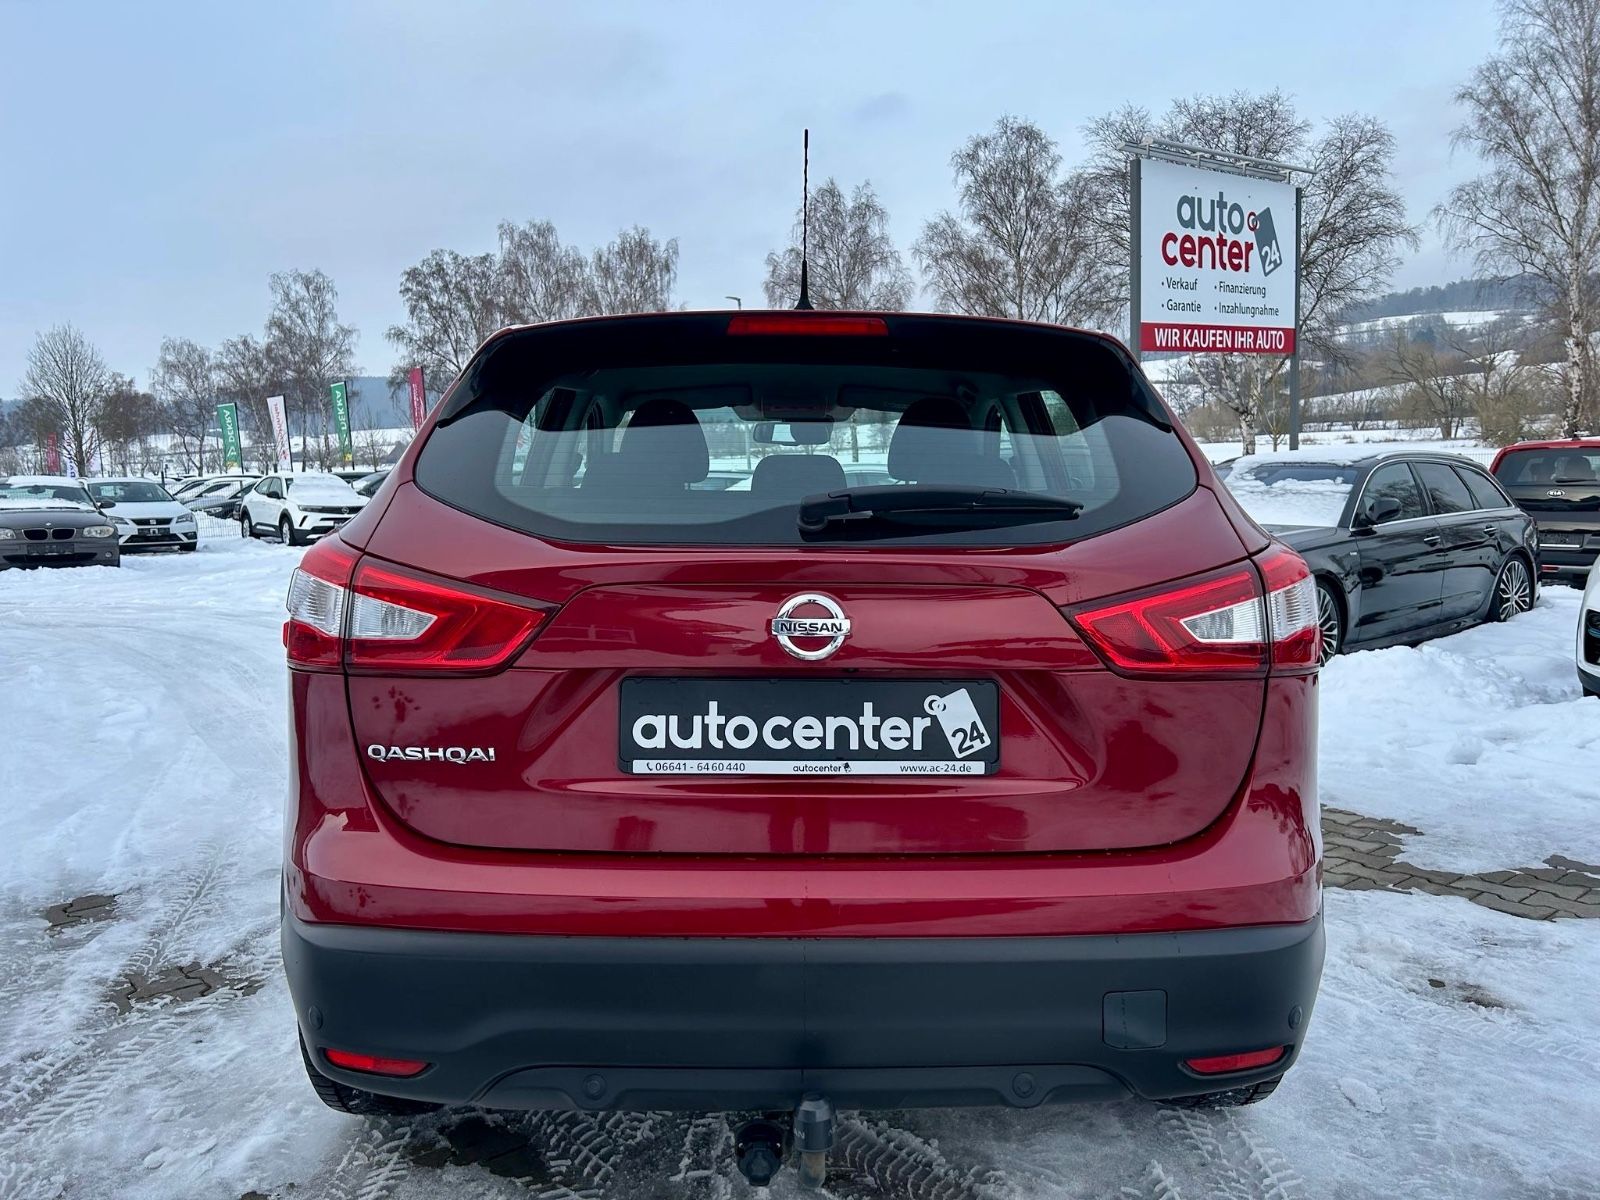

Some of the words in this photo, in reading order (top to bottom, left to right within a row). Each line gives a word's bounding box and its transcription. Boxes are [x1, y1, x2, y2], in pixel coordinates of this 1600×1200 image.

[1177, 192, 1244, 235] auto
[1161, 232, 1254, 272] center
[1261, 240, 1280, 273] 24
[1166, 277, 1198, 291] Verkauf
[1219, 281, 1266, 298] Finanzierung
[1166, 299, 1201, 313] Garantie
[1219, 302, 1280, 318] Inzahlungnahme
[1155, 328, 1180, 347] WIR
[1183, 329, 1231, 348] KAUFEN
[1234, 330, 1254, 349] IHR
[1255, 330, 1285, 350] AUTO
[780, 622, 842, 633] NISSAN
[632, 701, 931, 751] autocenter
[951, 720, 985, 754] 24
[367, 744, 496, 764] QASHQAI
[655, 762, 687, 772] 06641
[792, 763, 842, 773] autocenter
[899, 763, 972, 773] www.ac-24.de
